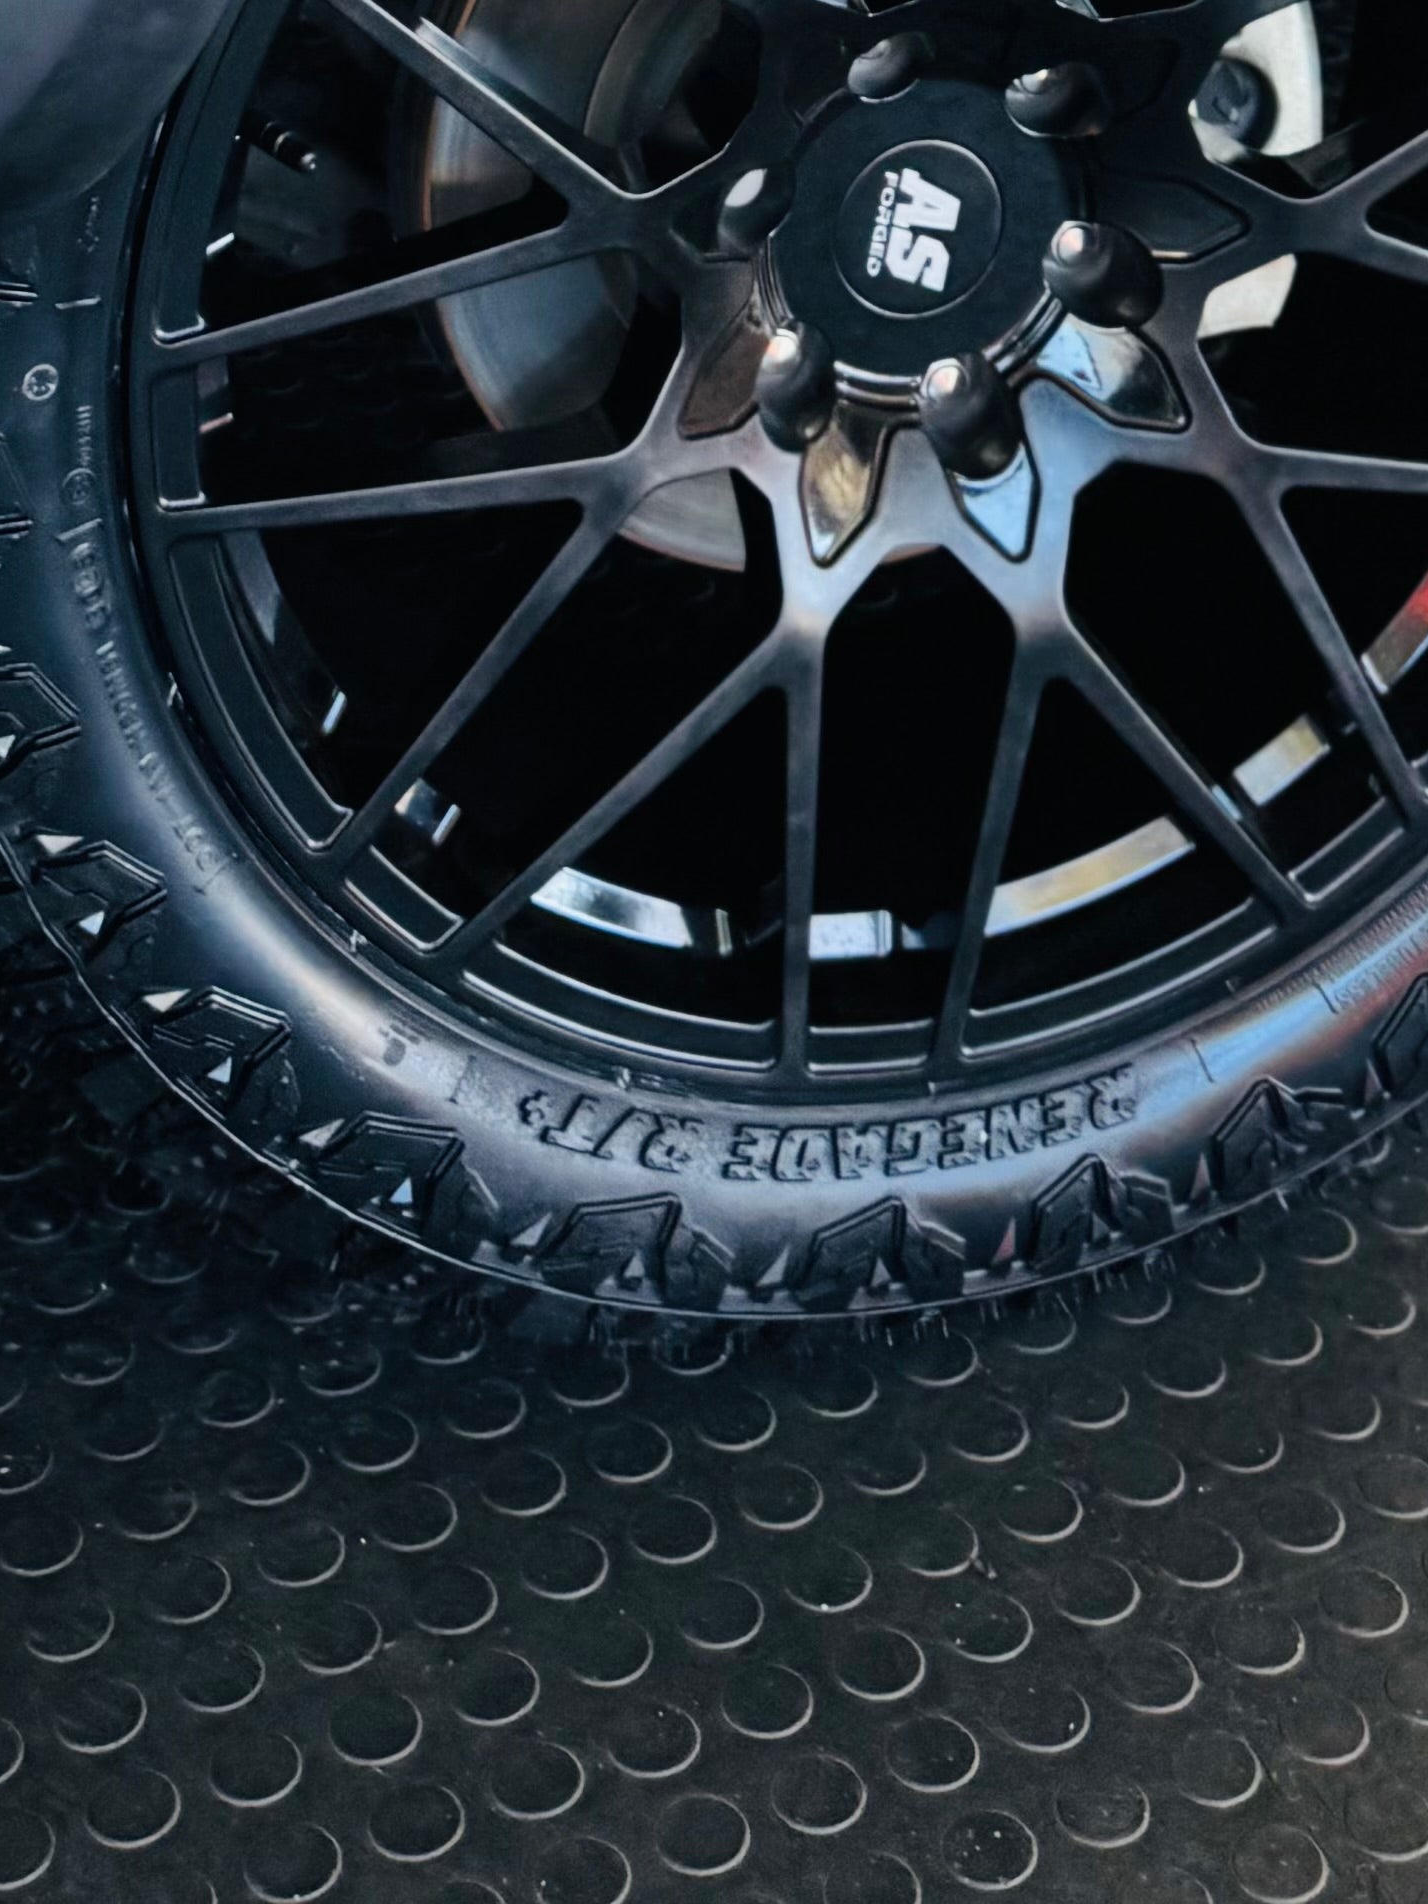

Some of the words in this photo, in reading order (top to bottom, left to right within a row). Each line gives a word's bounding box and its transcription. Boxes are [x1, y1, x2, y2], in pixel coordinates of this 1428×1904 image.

[866, 170, 899, 278] FORGED
[884, 167, 962, 292] AS
[721, 1063, 1138, 1182] RENEGADE
